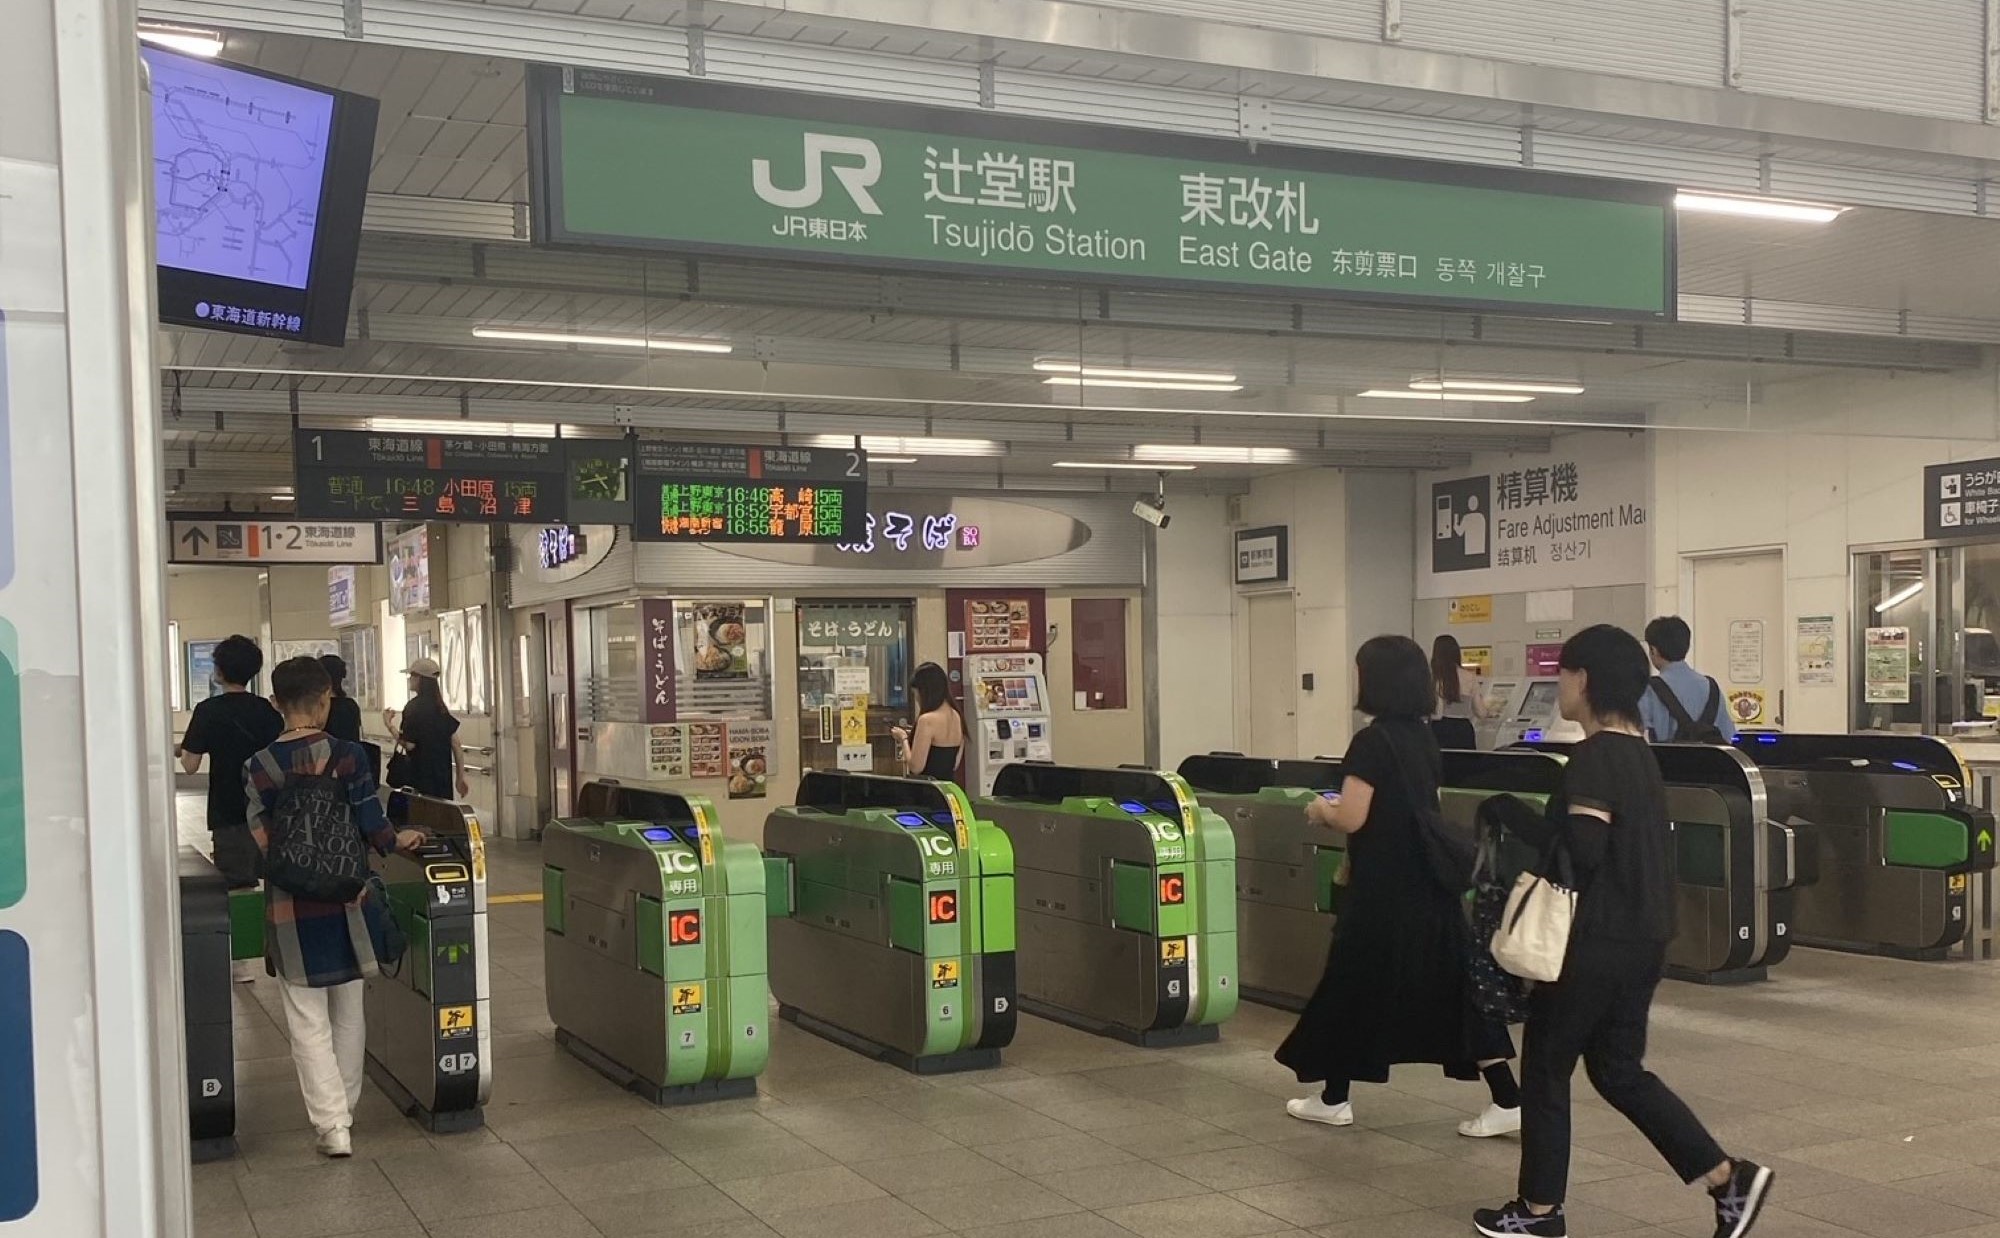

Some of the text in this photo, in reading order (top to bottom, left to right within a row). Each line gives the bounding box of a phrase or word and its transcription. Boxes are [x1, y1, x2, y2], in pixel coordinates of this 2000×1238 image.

[752, 132, 883, 215] JR
[922, 145, 1077, 214] 辻堂駅
[1178, 171, 1320, 236] 東改札
[772, 215, 868, 242] JR東日本
[924, 214, 1146, 263] Tsujidō Station
[1178, 236, 1313, 274] East Gate
[1331, 248, 1419, 279] 东剪票口
[1434, 257, 1547, 289] 동쪽 개찰구
[211, 303, 302, 332] 東海道新幹線
[311, 435, 323, 461] 1
[368, 437, 424, 453] 東海道線
[764, 450, 812, 464] 東海道線
[845, 452, 861, 477] 2
[327, 476, 537, 499] 普通 16:48 小田原 15両
[727, 487, 769, 503] 16:46
[814, 488, 843, 505] 15両
[1496, 461, 1578, 511] 精算機
[727, 503, 769, 519] 16:52
[769, 503, 813, 521] 宇都宮
[814, 505, 843, 521] 15両
[1964, 499, 1999, 515] 車椅子
[304, 525, 356, 539] 東海道線
[727, 519, 769, 535] 16:55
[814, 520, 843, 536] 15両
[1497, 518, 1528, 540] Fare
[1533, 507, 1614, 540] Adjustment
[1497, 544, 1538, 567] 结算机
[1549, 539, 1592, 563] 정산기
[807, 618, 894, 638] そば・うどん
[652, 618, 670, 706] そば・うどん
[1143, 821, 1181, 842] IC
[919, 836, 953, 857] IC
[659, 851, 697, 874] IC
[929, 861, 955, 876] 専用
[669, 878, 697, 893] 専用
[1161, 877, 1183, 901] IC
[930, 895, 955, 921] IC
[671, 914, 698, 942] IC
[1220, 977, 1226, 986] 4
[942, 1005, 949, 1015] 6
[997, 999, 1004, 1009] 5
[684, 1032, 691, 1043] 7
[746, 1026, 753, 1037] 6
[444, 1055, 472, 1068] 8 7
[205, 1082, 215, 1093] 8
